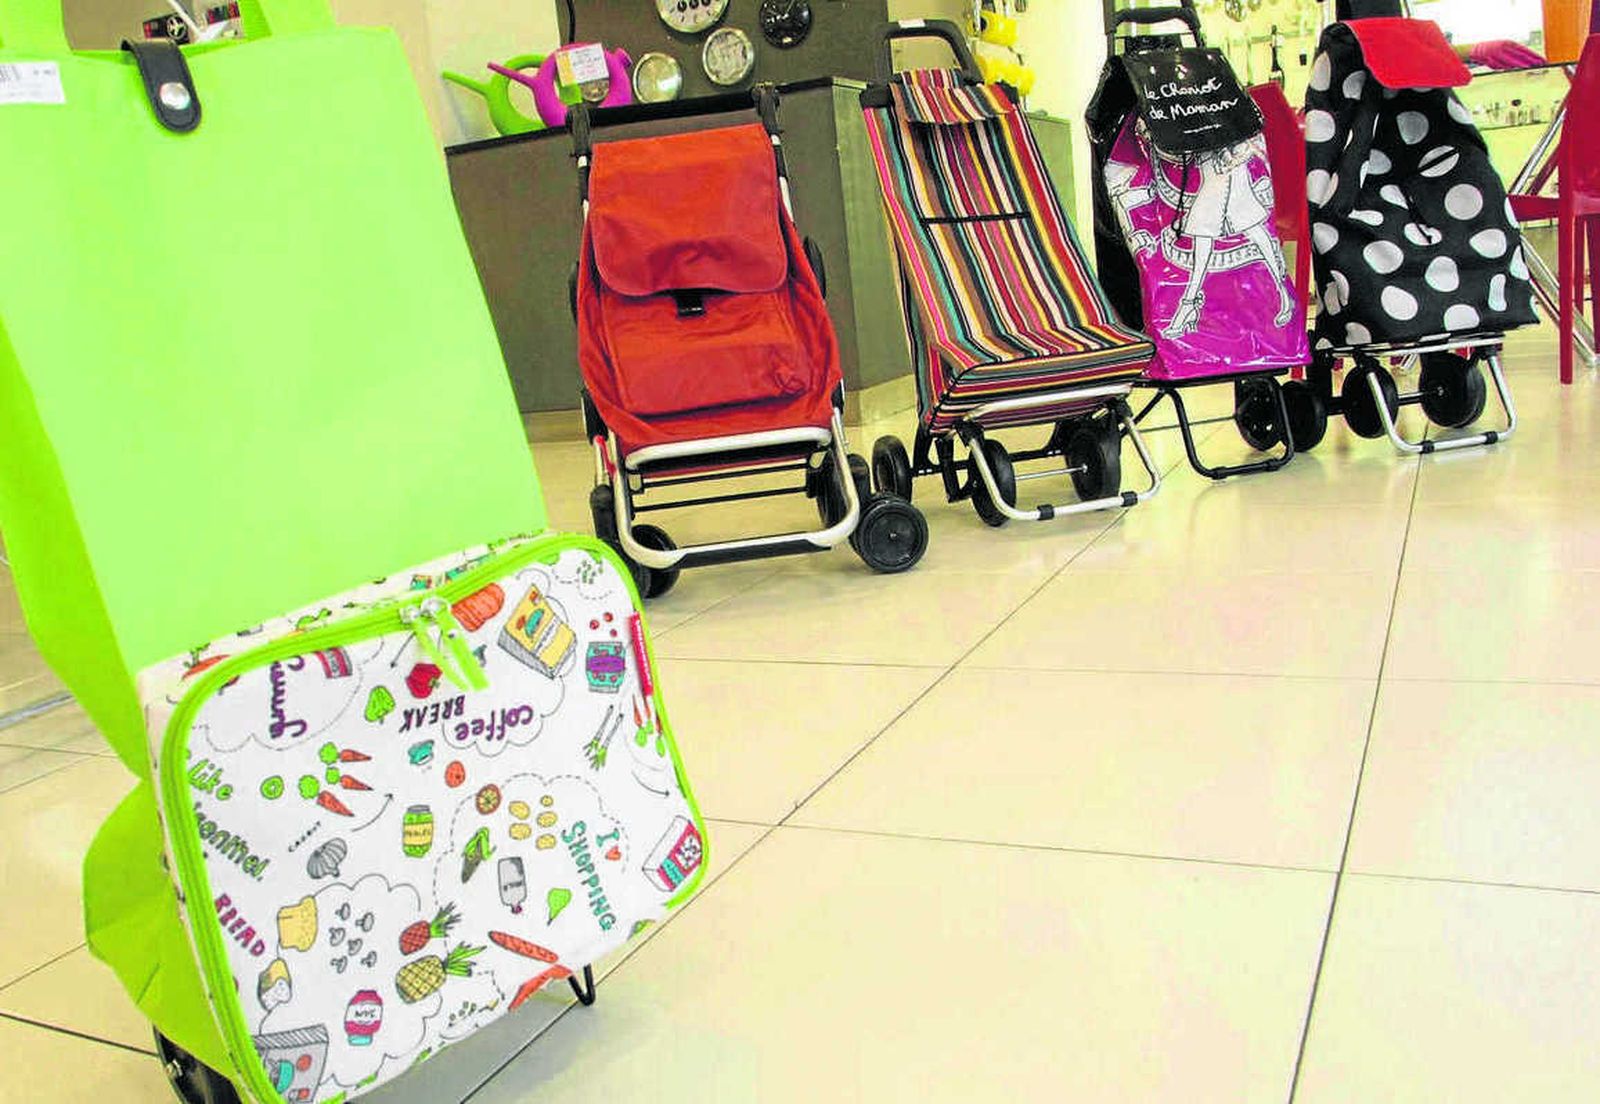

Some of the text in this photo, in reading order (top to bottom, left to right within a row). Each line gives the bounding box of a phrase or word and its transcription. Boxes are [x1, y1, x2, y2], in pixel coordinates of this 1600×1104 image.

[1160, 77, 1222, 98] Chariot
[1149, 98, 1239, 120] de Maman
[399, 695, 466, 733] BREAK
[453, 705, 534, 742] coffee
[595, 828, 620, 848] I
[561, 820, 617, 931] SHOPPING
